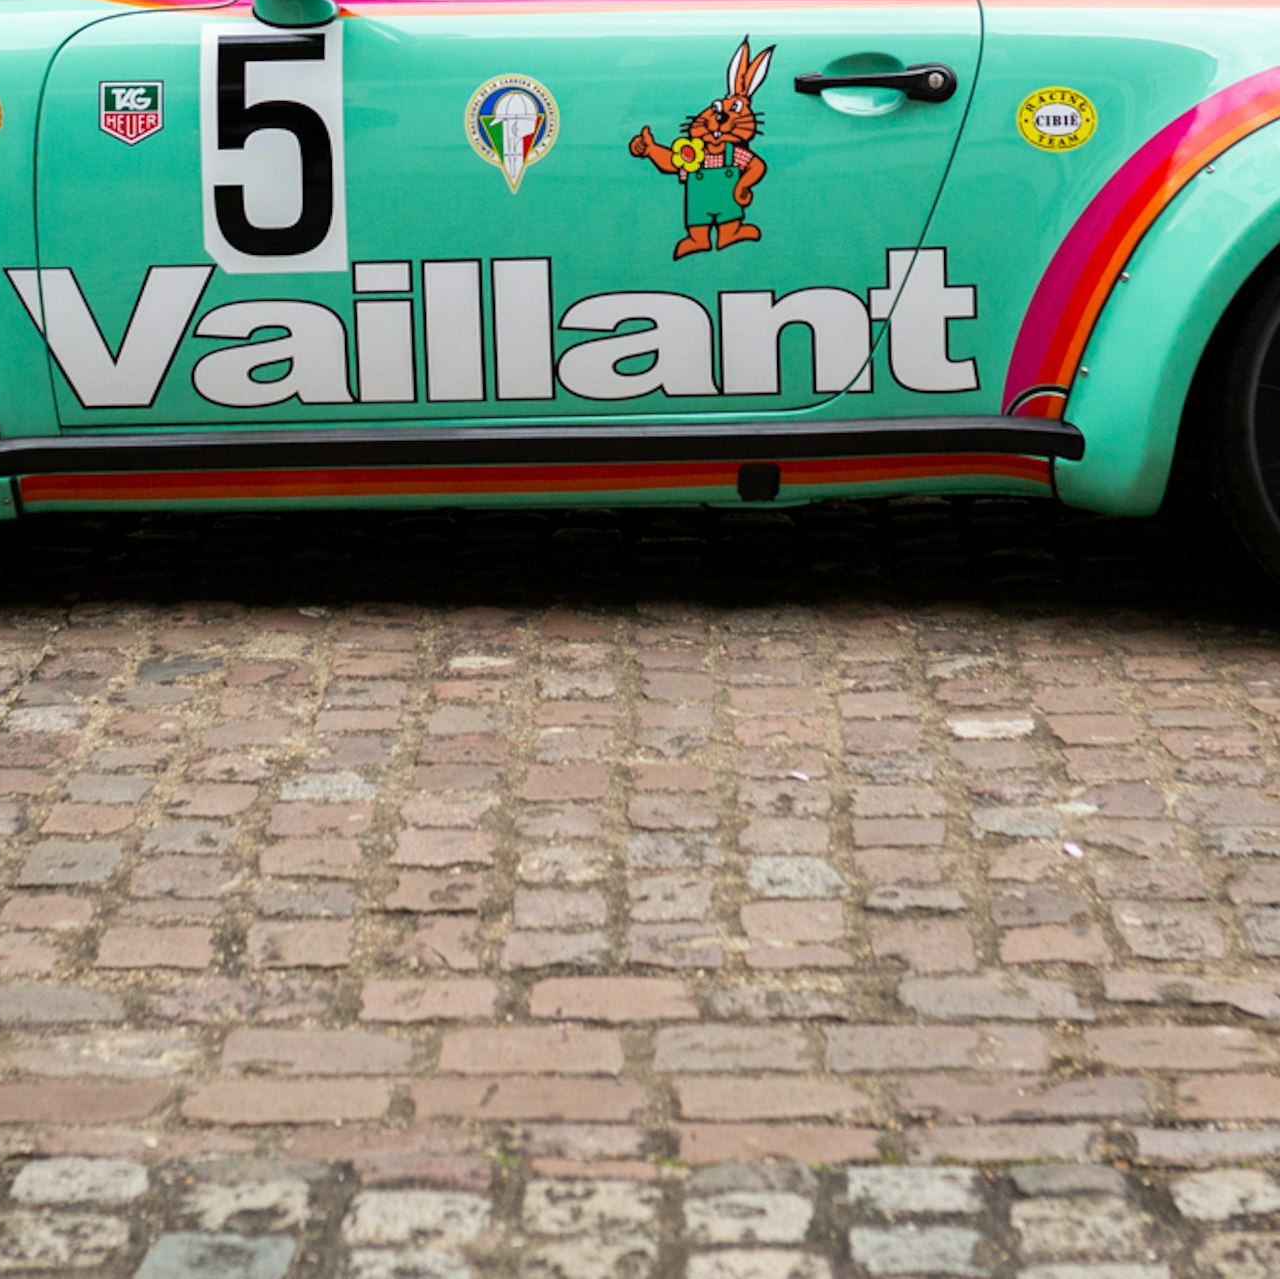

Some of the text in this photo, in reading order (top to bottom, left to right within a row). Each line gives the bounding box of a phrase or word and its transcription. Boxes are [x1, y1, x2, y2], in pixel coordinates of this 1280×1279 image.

[111, 87, 152, 111] TAG
[1025, 92, 1087, 112] RACING
[105, 114, 158, 139] HEUER
[214, 33, 333, 256] 5
[1038, 134, 1079, 145] TEAM
[3, 246, 980, 408] Vaillant
